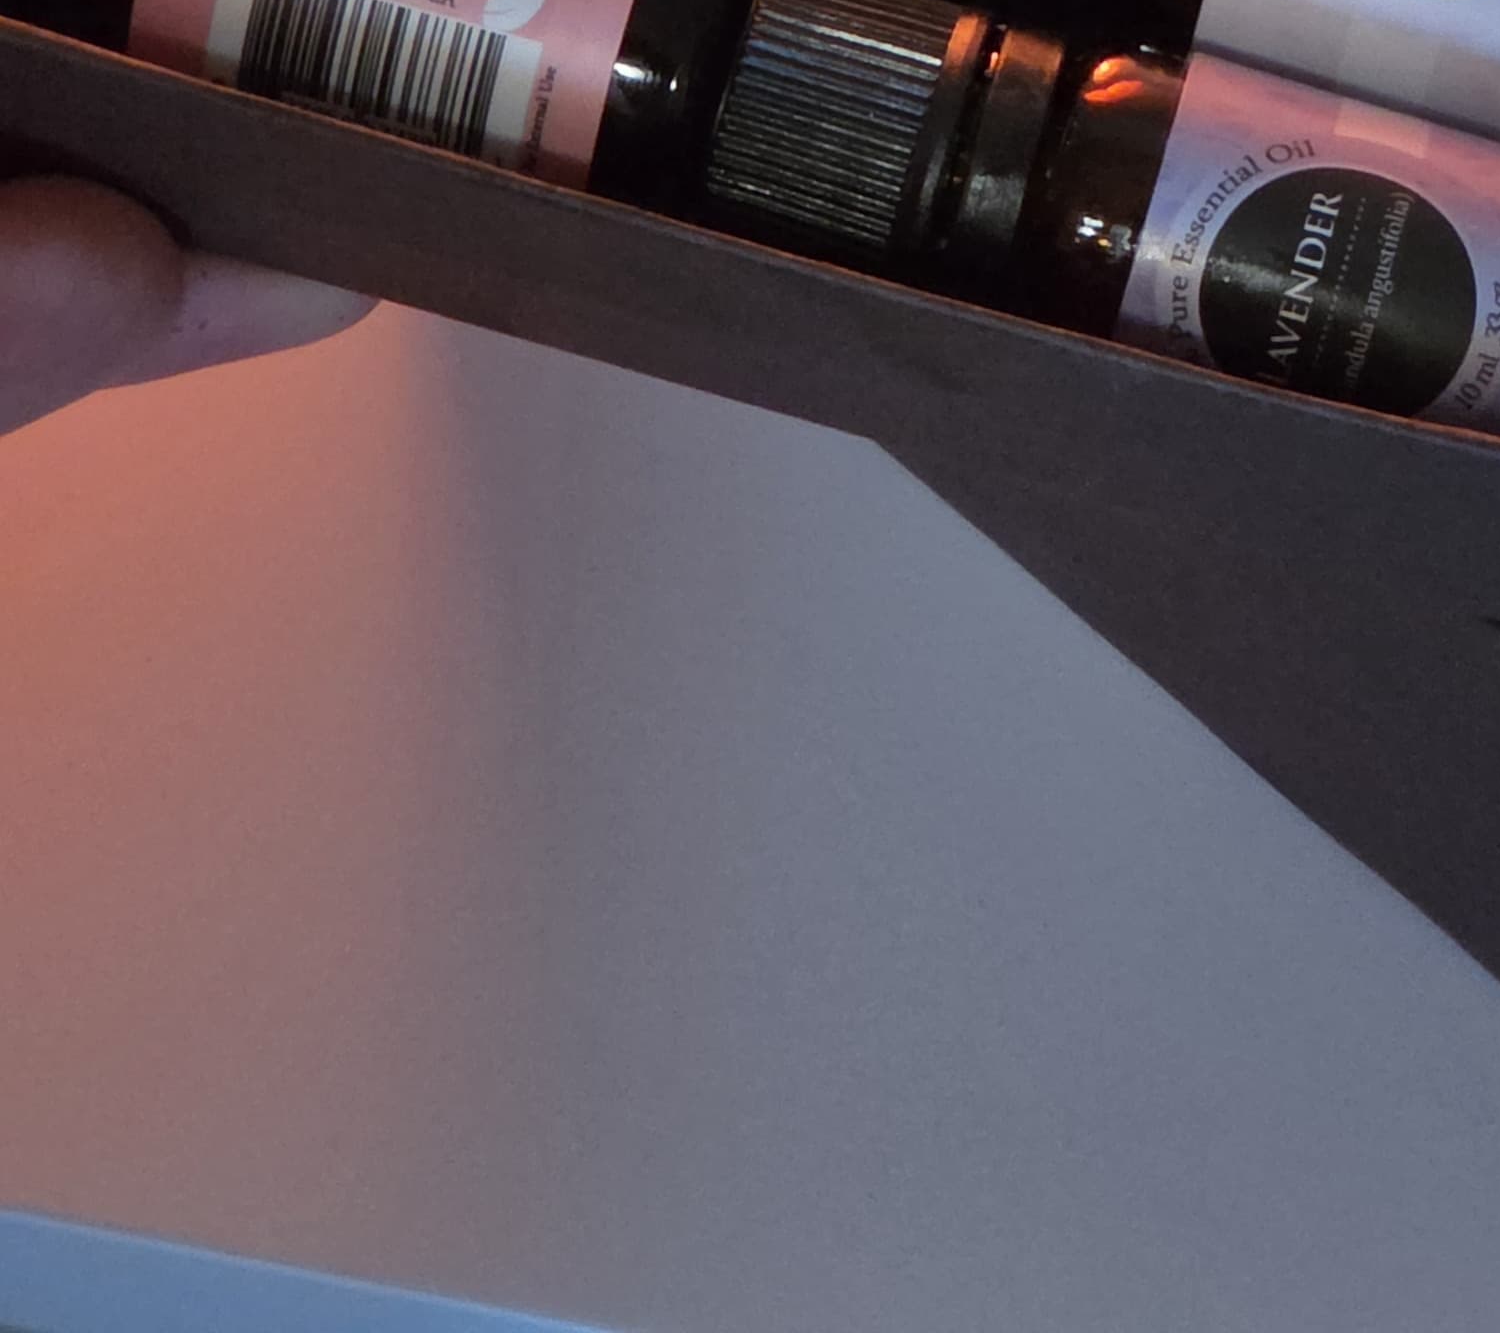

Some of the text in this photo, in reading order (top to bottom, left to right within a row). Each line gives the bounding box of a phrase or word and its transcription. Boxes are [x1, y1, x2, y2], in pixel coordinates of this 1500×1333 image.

[1168, 137, 1317, 339] Pure Essential Oil
[1366, 191, 1416, 325] angustifolia)
[1453, 379, 1482, 412] 10
[1475, 352, 1500, 390] ml
